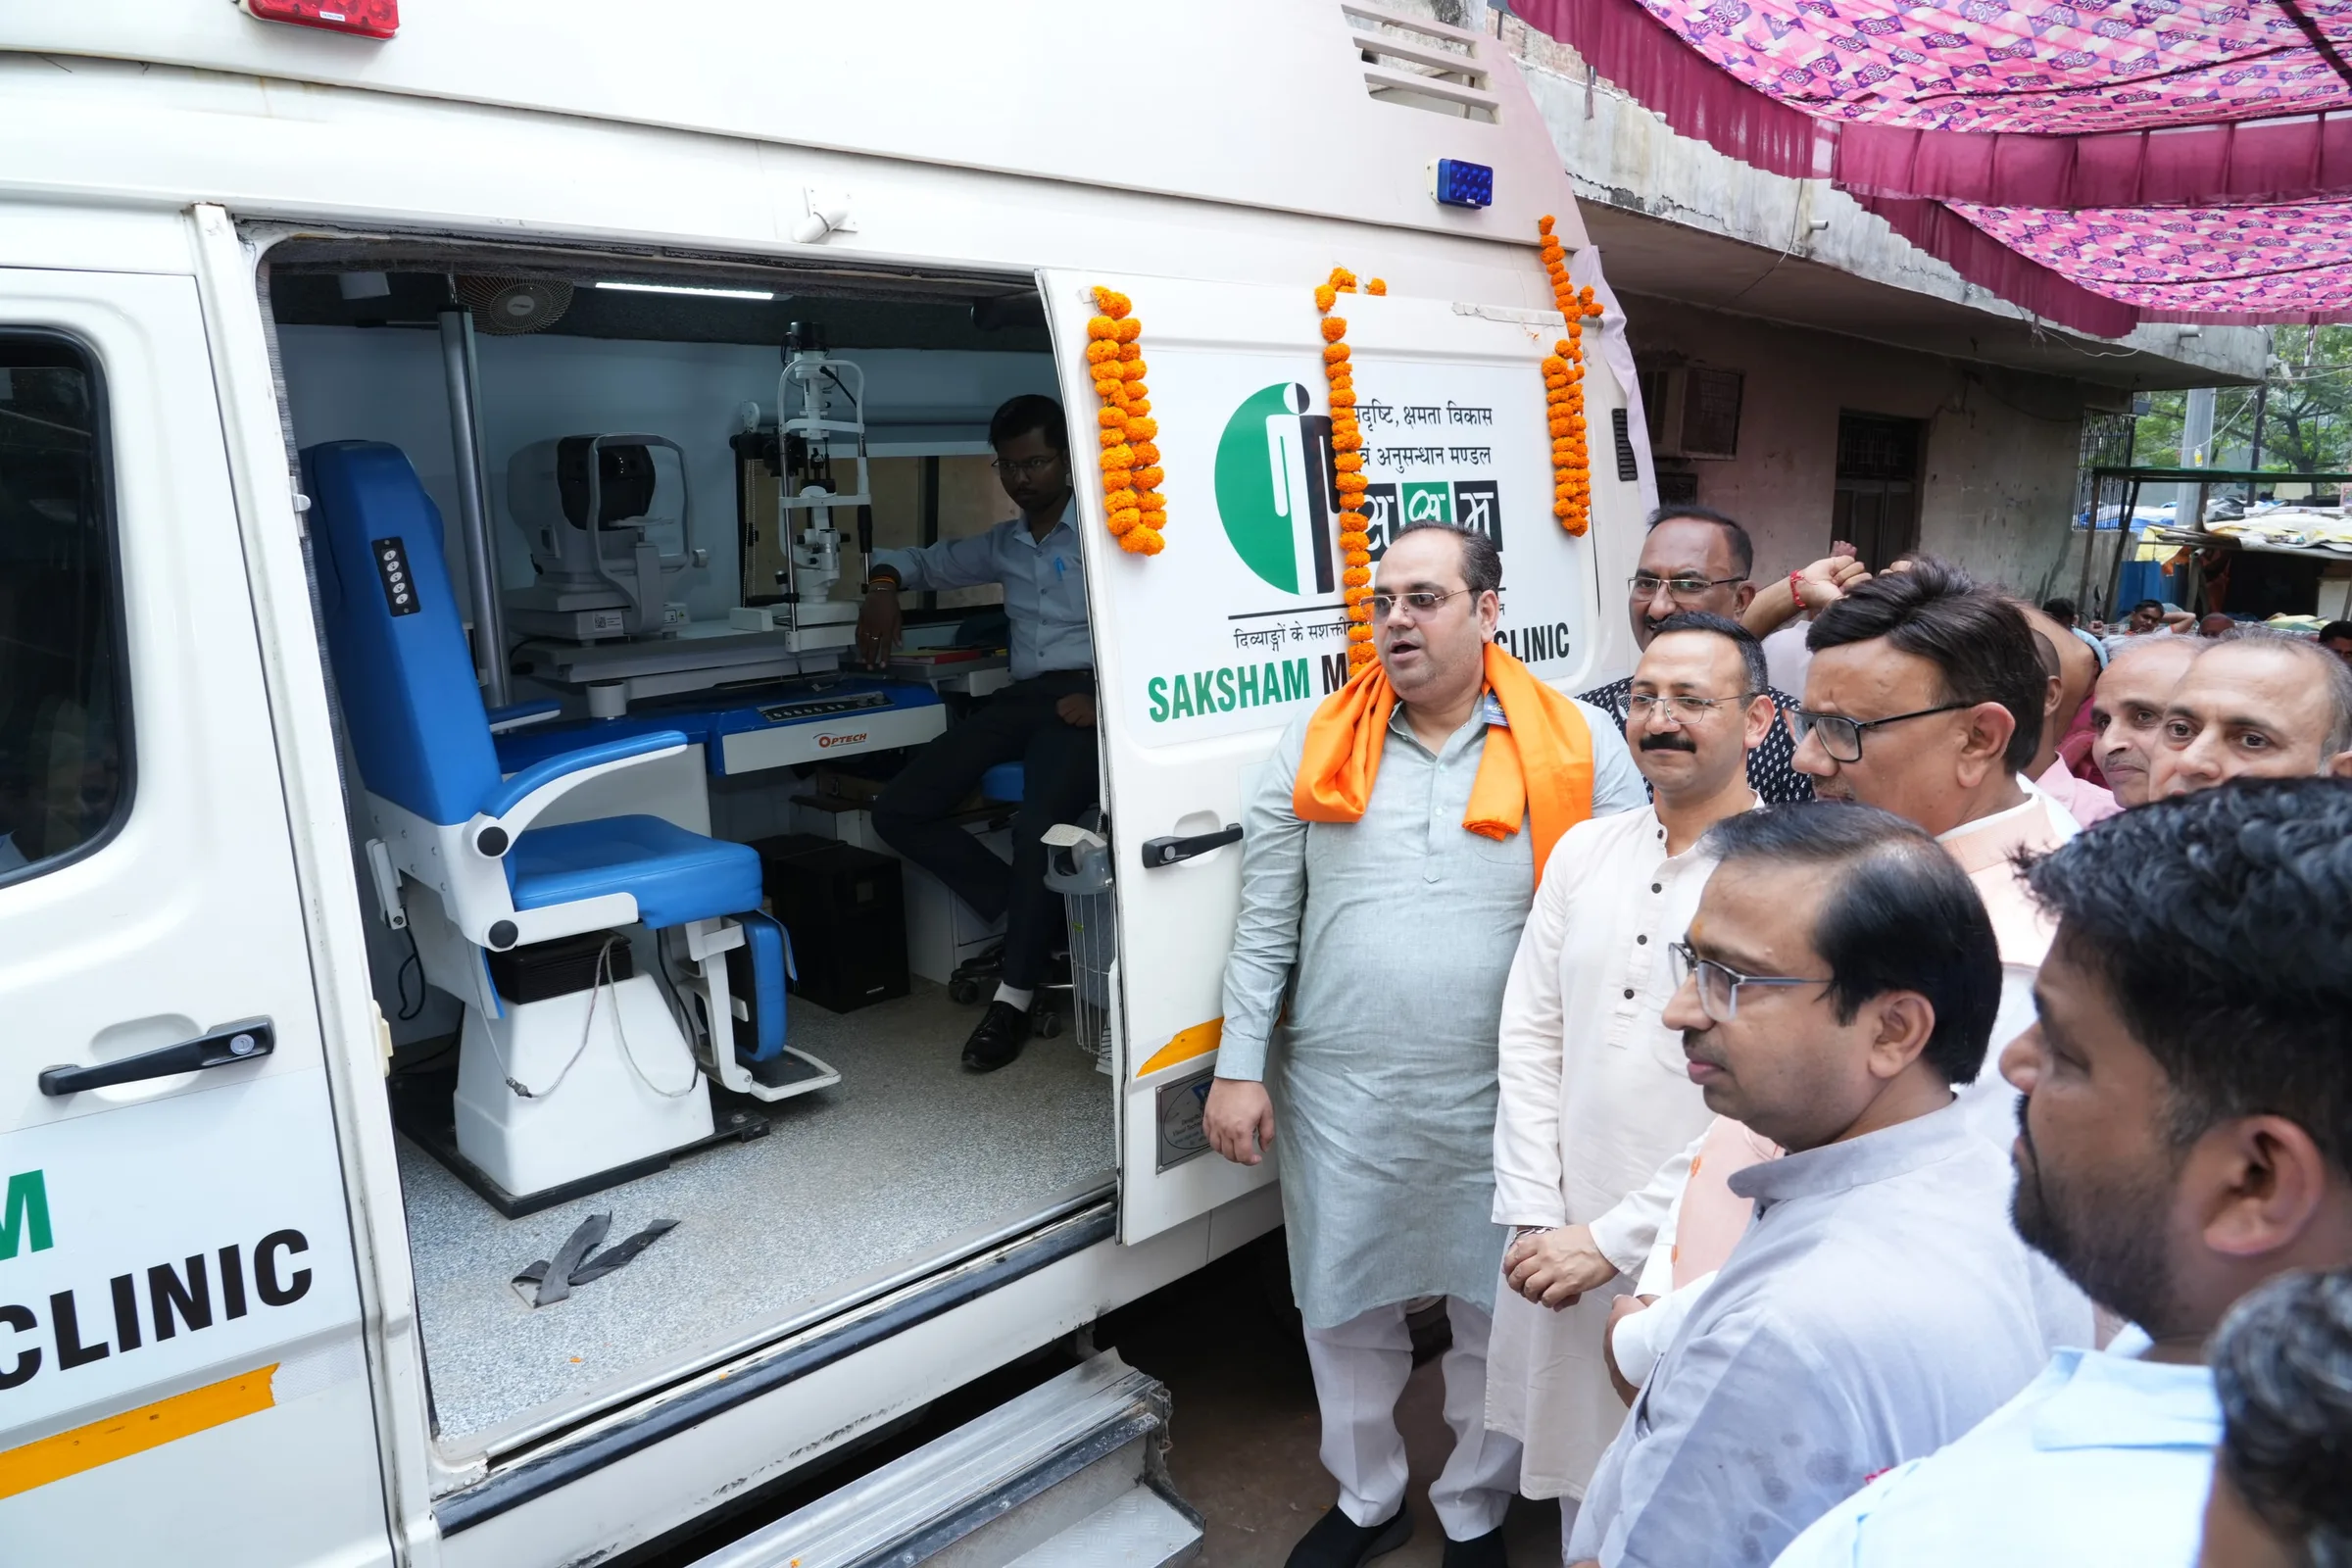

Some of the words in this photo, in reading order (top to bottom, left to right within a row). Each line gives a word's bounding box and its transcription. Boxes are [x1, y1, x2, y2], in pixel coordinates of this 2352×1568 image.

[1403, 406, 1442, 429] क्षमता
[1446, 400, 1494, 425] विकास
[1377, 446, 1445, 474] अनुसन्धान
[1447, 446, 1492, 466] मण्डल
[1290, 620, 1303, 642] के
[1148, 658, 1311, 723] SAKSHAM
[818, 733, 867, 748] OPTECH
[0, 1228, 313, 1391] CLINIC
